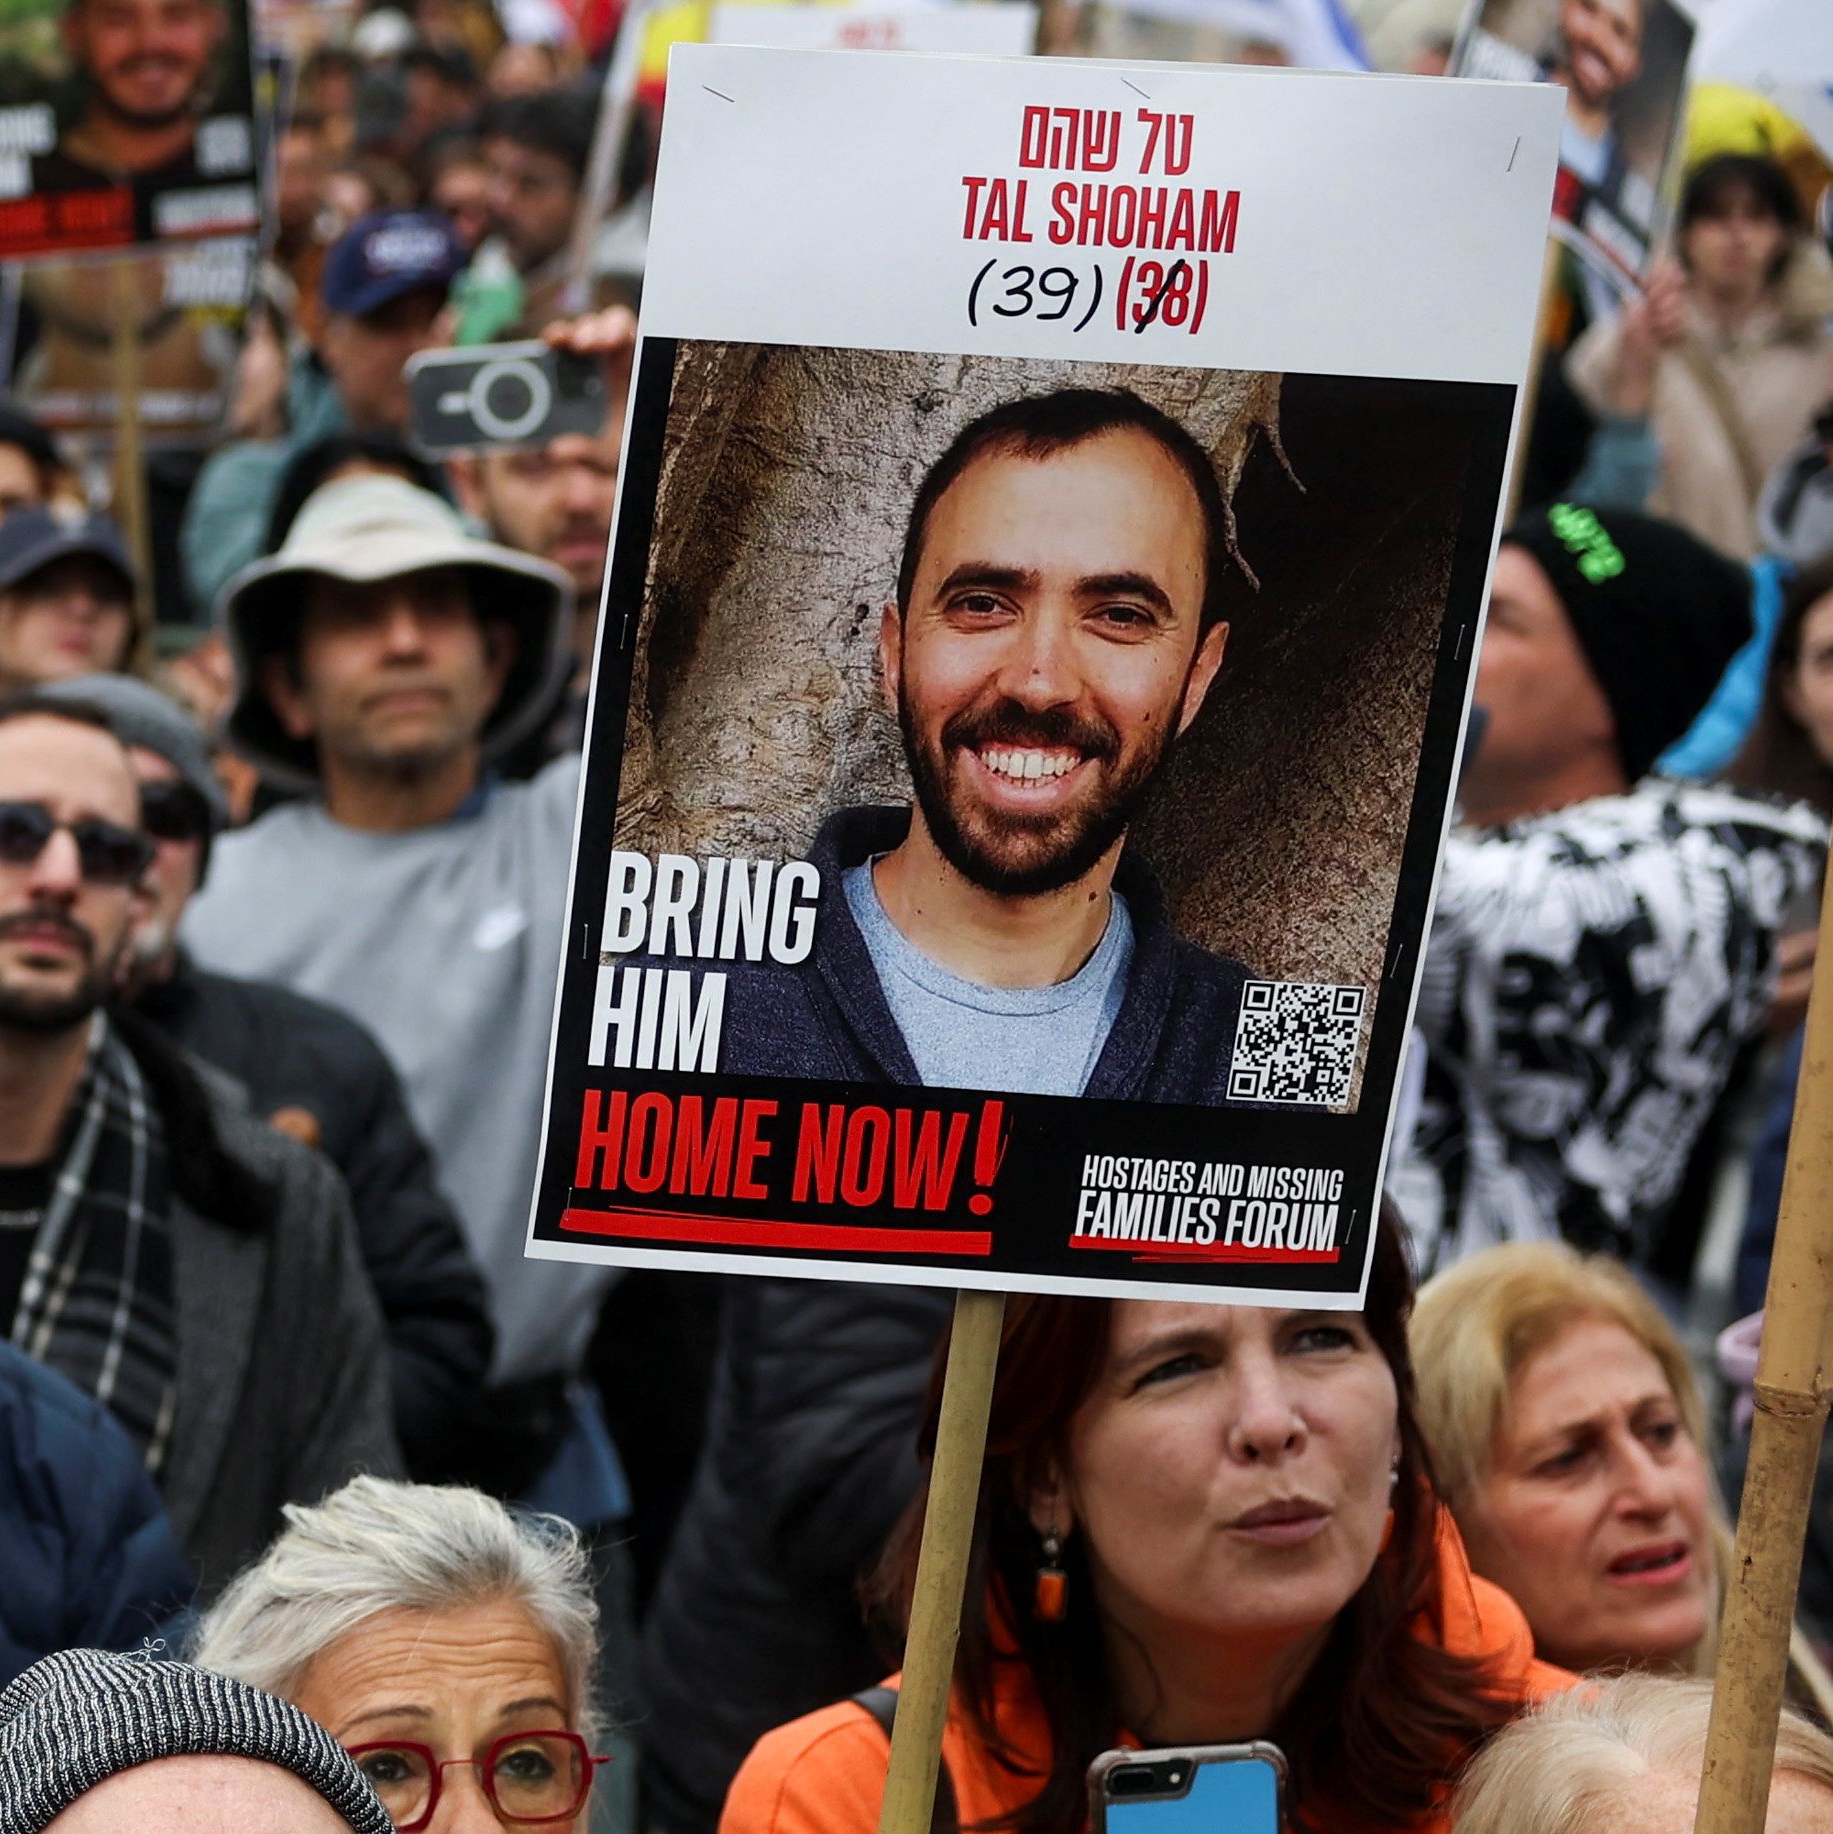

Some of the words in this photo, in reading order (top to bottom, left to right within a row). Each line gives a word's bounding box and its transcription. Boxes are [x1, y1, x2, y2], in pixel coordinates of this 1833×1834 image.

[1019, 105, 1122, 172] שהם
[1137, 107, 1195, 175] טל
[961, 176, 1034, 242] TAL
[1048, 181, 1241, 253] SHOHAM
[968, 258, 1103, 332] (39)
[1116, 256, 1209, 334] (38)
[599, 850, 821, 965] BRING
[587, 965, 728, 1074] HIM
[574, 1088, 779, 1200] HOME
[791, 1099, 1007, 1216] NOW!
[1081, 1154, 1197, 1194] HOSTAGES
[1197, 1163, 1245, 1197] AND
[1246, 1166, 1344, 1202] MISSING
[1074, 1190, 1221, 1246] FAMILIES
[1223, 1200, 1340, 1252] FORUM
